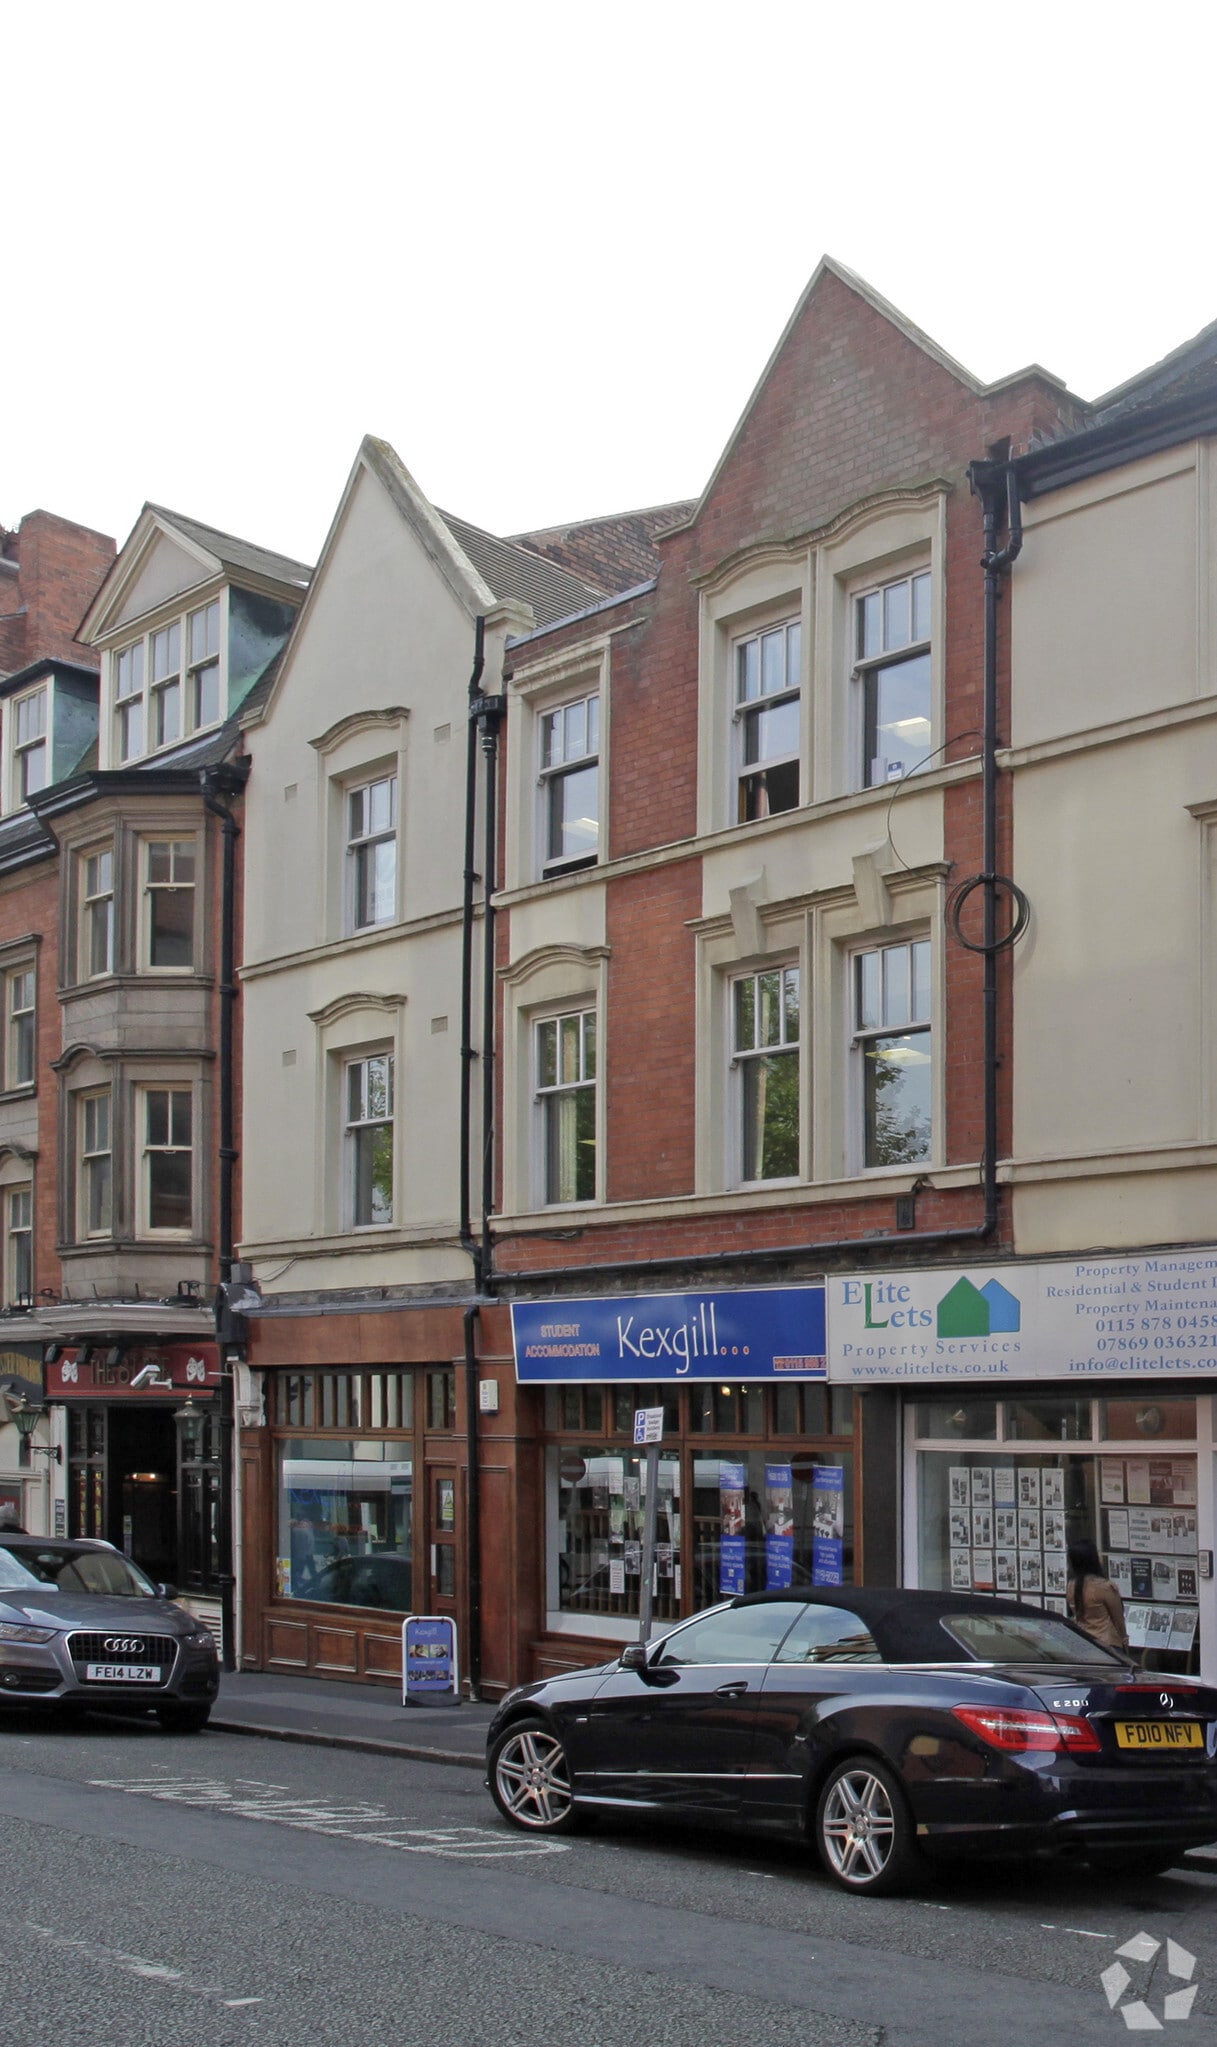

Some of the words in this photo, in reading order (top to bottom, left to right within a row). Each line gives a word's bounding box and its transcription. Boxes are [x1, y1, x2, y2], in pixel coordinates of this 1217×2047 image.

[1075, 1264, 1140, 1278] Property
[1047, 1282, 1126, 1298] Residential
[1130, 1282, 1142, 1293] &
[1147, 1278, 1207, 1292] Student
[1075, 1302, 1140, 1316] Property
[540, 1323, 580, 1338] STUDENT
[1095, 1319, 1135, 1332] 0115
[1141, 1317, 1172, 1330] 878
[525, 1343, 600, 1358] ACCOMMODATION
[842, 1342, 929, 1359] Property
[935, 1340, 1021, 1354] Services
[1097, 1338, 1149, 1351] 07869
[852, 1361, 1009, 1375] www.elitelets.co.uk
[638, 1412, 645, 1425] P
[95, 1666, 124, 1678] FE14
[128, 1668, 153, 1679] LZW
[1125, 1725, 1161, 1743] FD10
[1165, 1725, 1193, 1743] NFV
